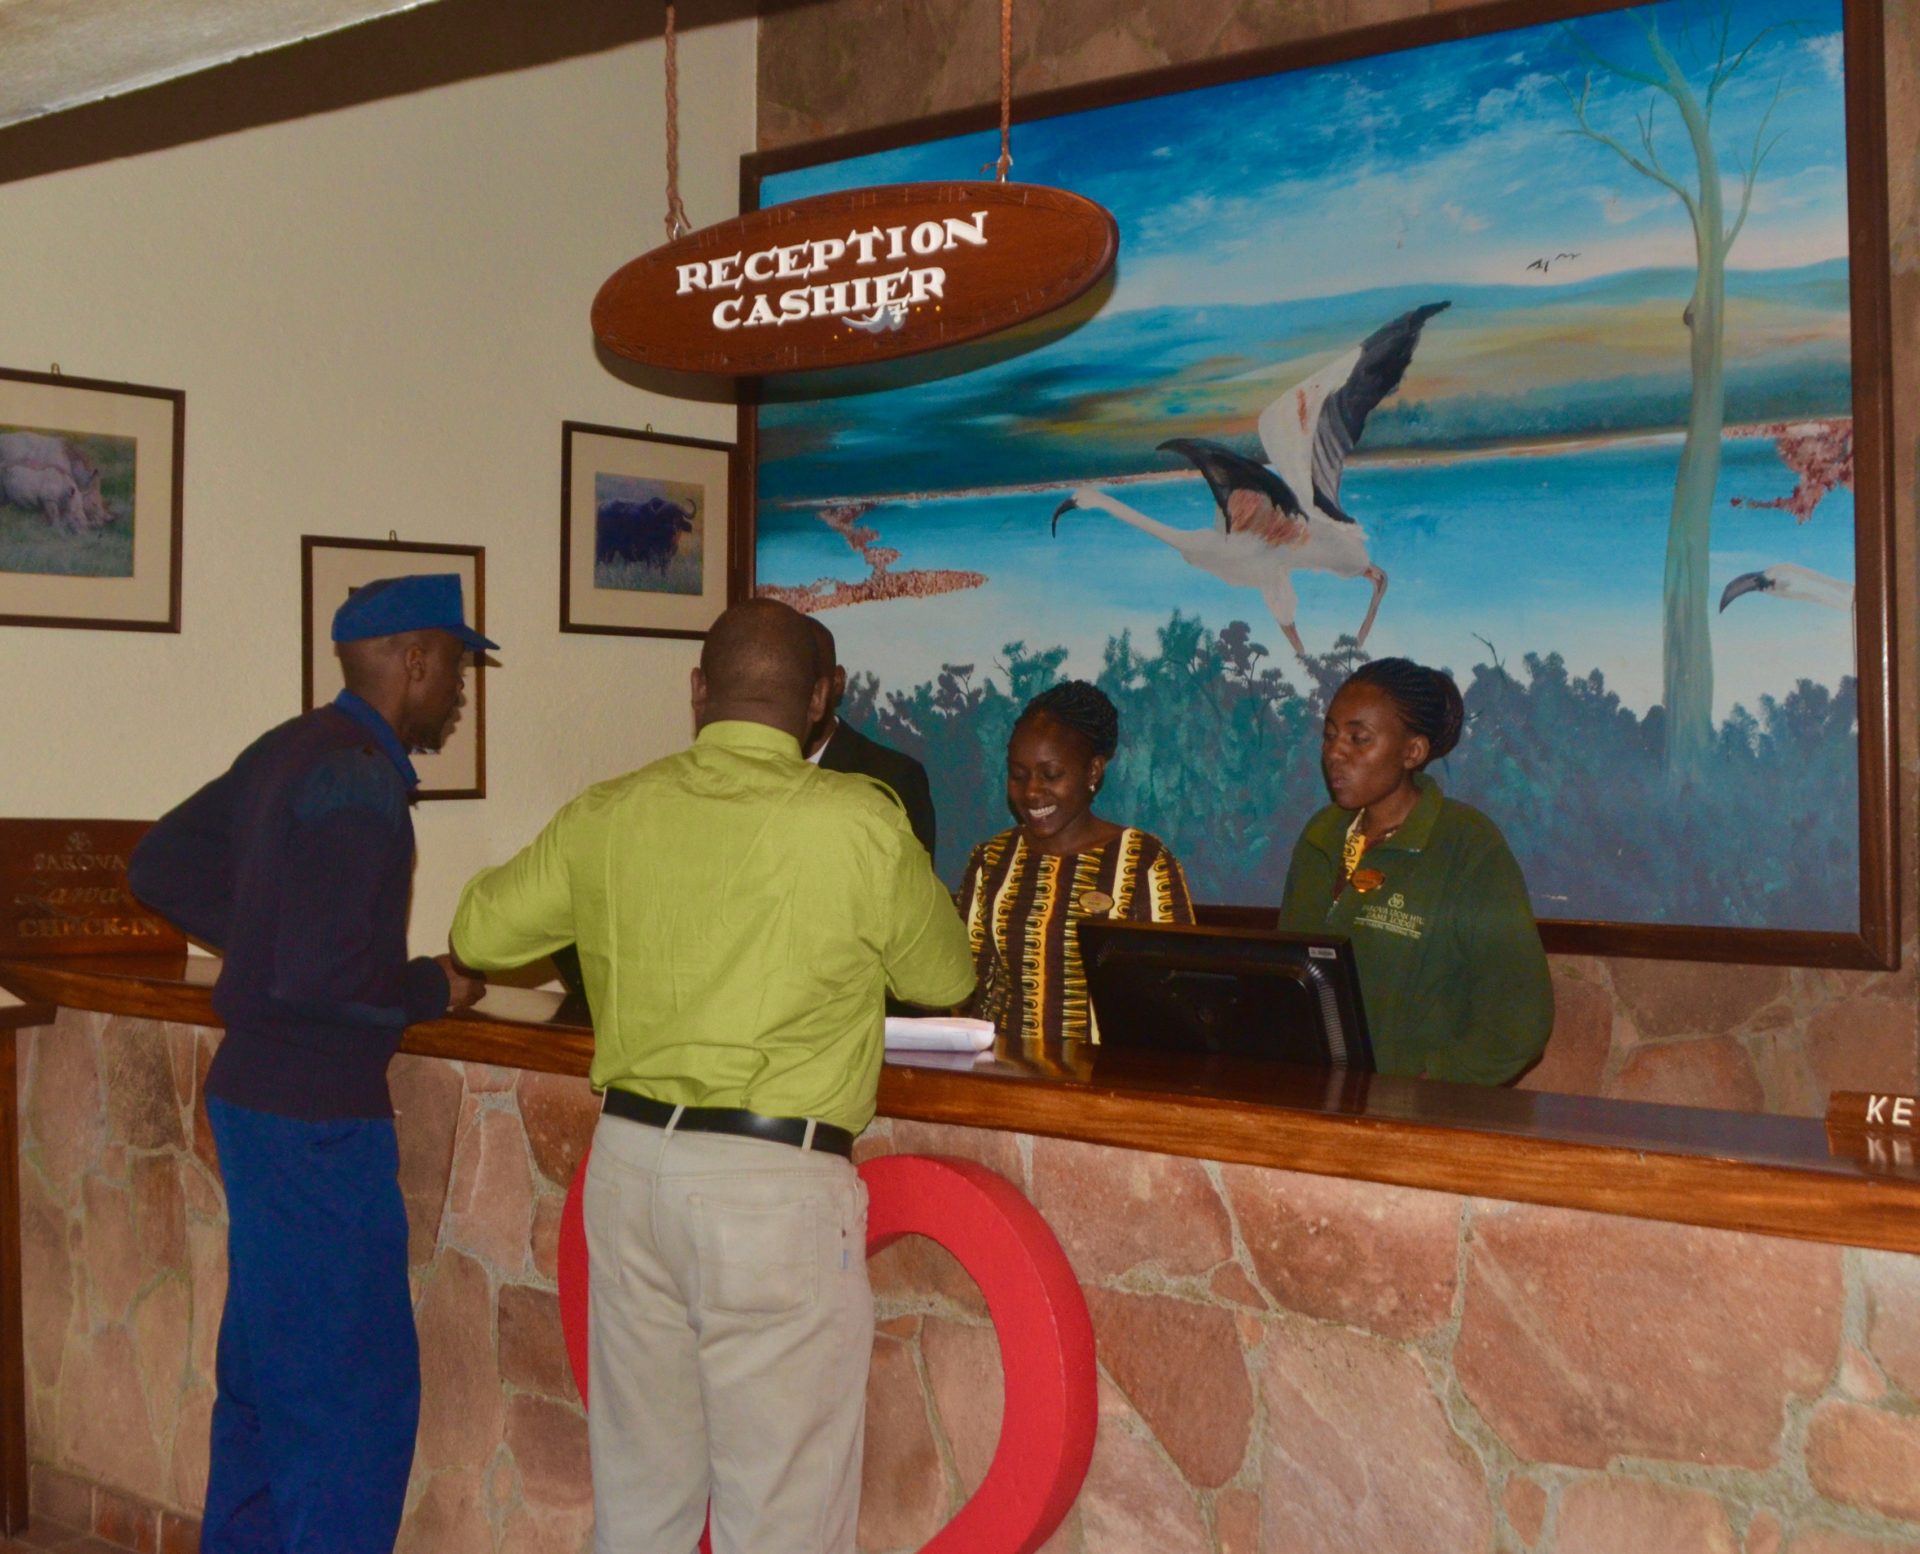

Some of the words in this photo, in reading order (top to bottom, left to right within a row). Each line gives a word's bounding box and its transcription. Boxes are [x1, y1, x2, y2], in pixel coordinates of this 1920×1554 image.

[675, 211, 988, 295] RECEPTION
[712, 267, 946, 330] CASHIER
[33, 854, 128, 871] SAROVA
[18, 916, 160, 937] CHECK-IN
[1865, 1094, 1916, 1128] KE
